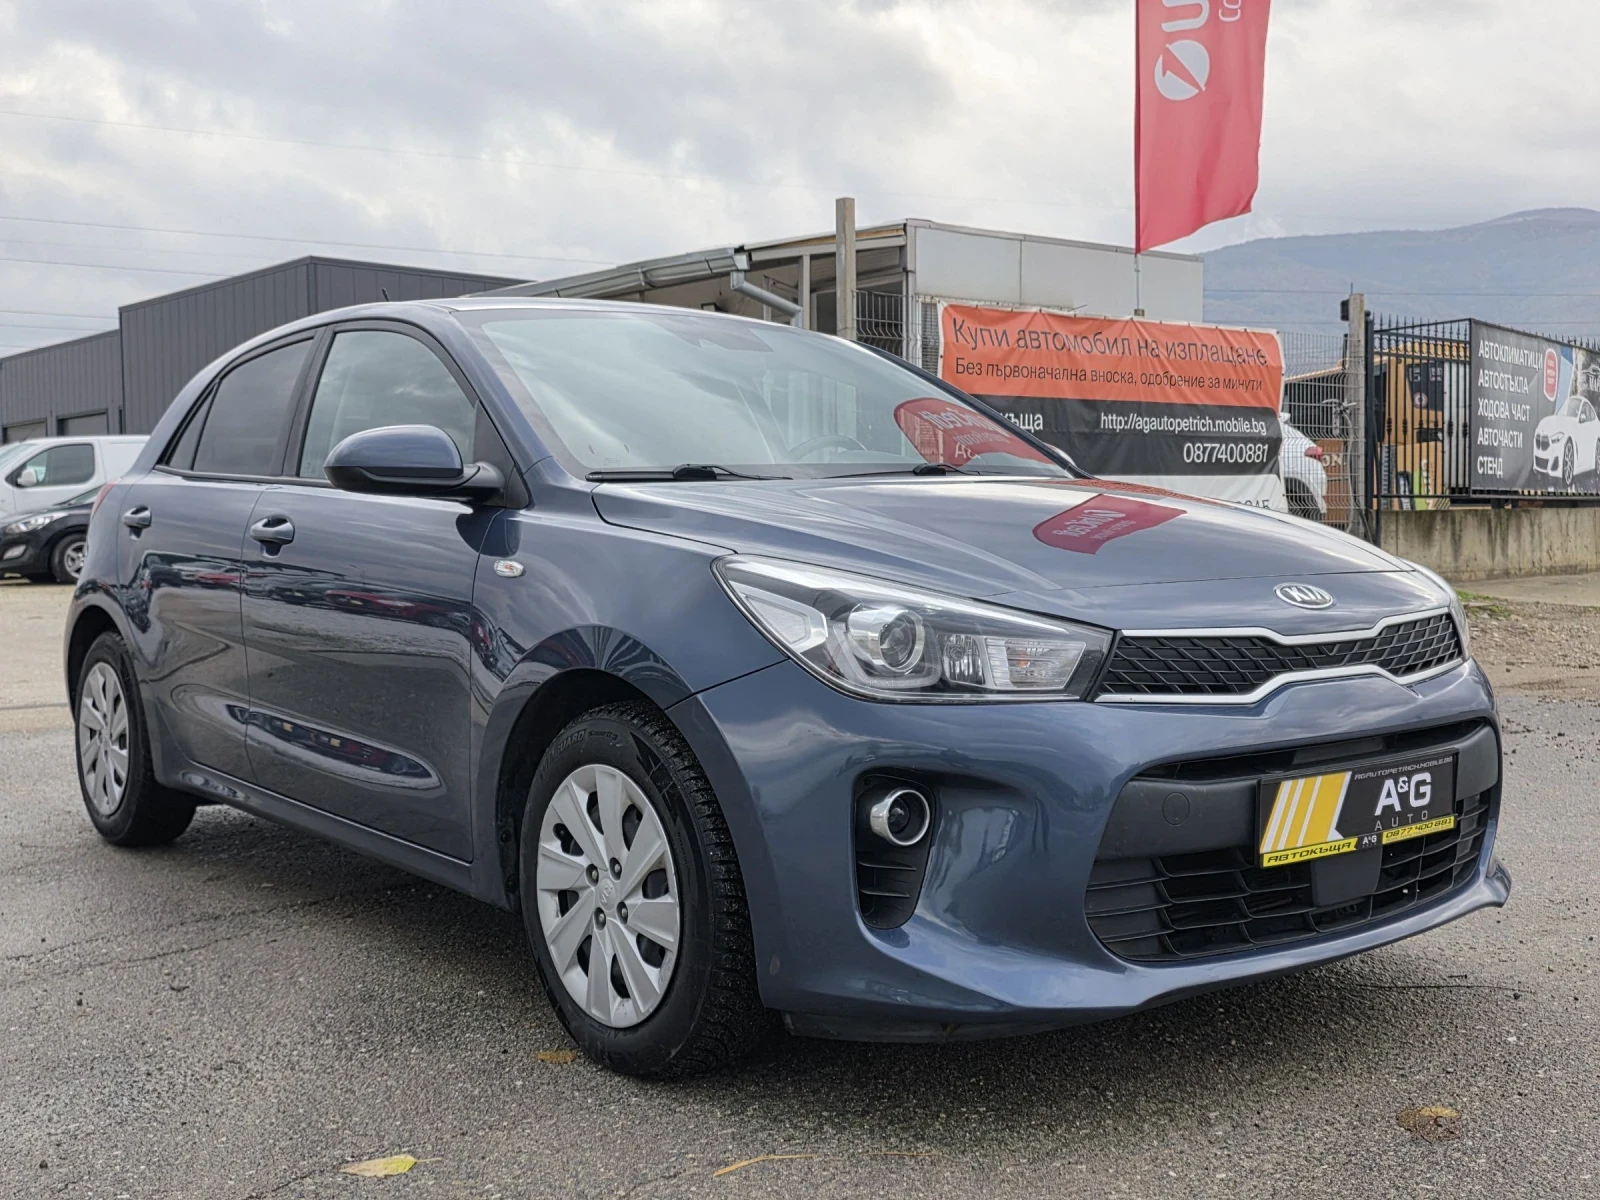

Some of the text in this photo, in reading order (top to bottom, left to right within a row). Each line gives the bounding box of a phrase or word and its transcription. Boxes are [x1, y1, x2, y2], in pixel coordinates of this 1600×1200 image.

[953, 318, 1268, 367] Купи автомобил на изплащане
[1478, 339, 1543, 371] АВТОКЛИМАТИЦИ
[955, 357, 1263, 392] Без първоначална вноска, одобрение за минути
[1478, 369, 1529, 395] АВТОСТЪКЛА
[1478, 397, 1531, 422] ХОДОВА ЧАСТ
[1100, 412, 1267, 435] http://agautopetrich.mobile.bg
[1477, 427, 1523, 449] АВТОЧАСТИ
[1183, 443, 1269, 463] 0877400881
[1477, 455, 1504, 479] СТЕНД
[1374, 772, 1432, 816] A&G
[1374, 810, 1428, 832] AUTO
[1385, 827, 1413, 839] 0877
[1414, 822, 1433, 832] 400
[1434, 817, 1452, 827] 881
[1267, 842, 1352, 863] АВТОКЪЩА
